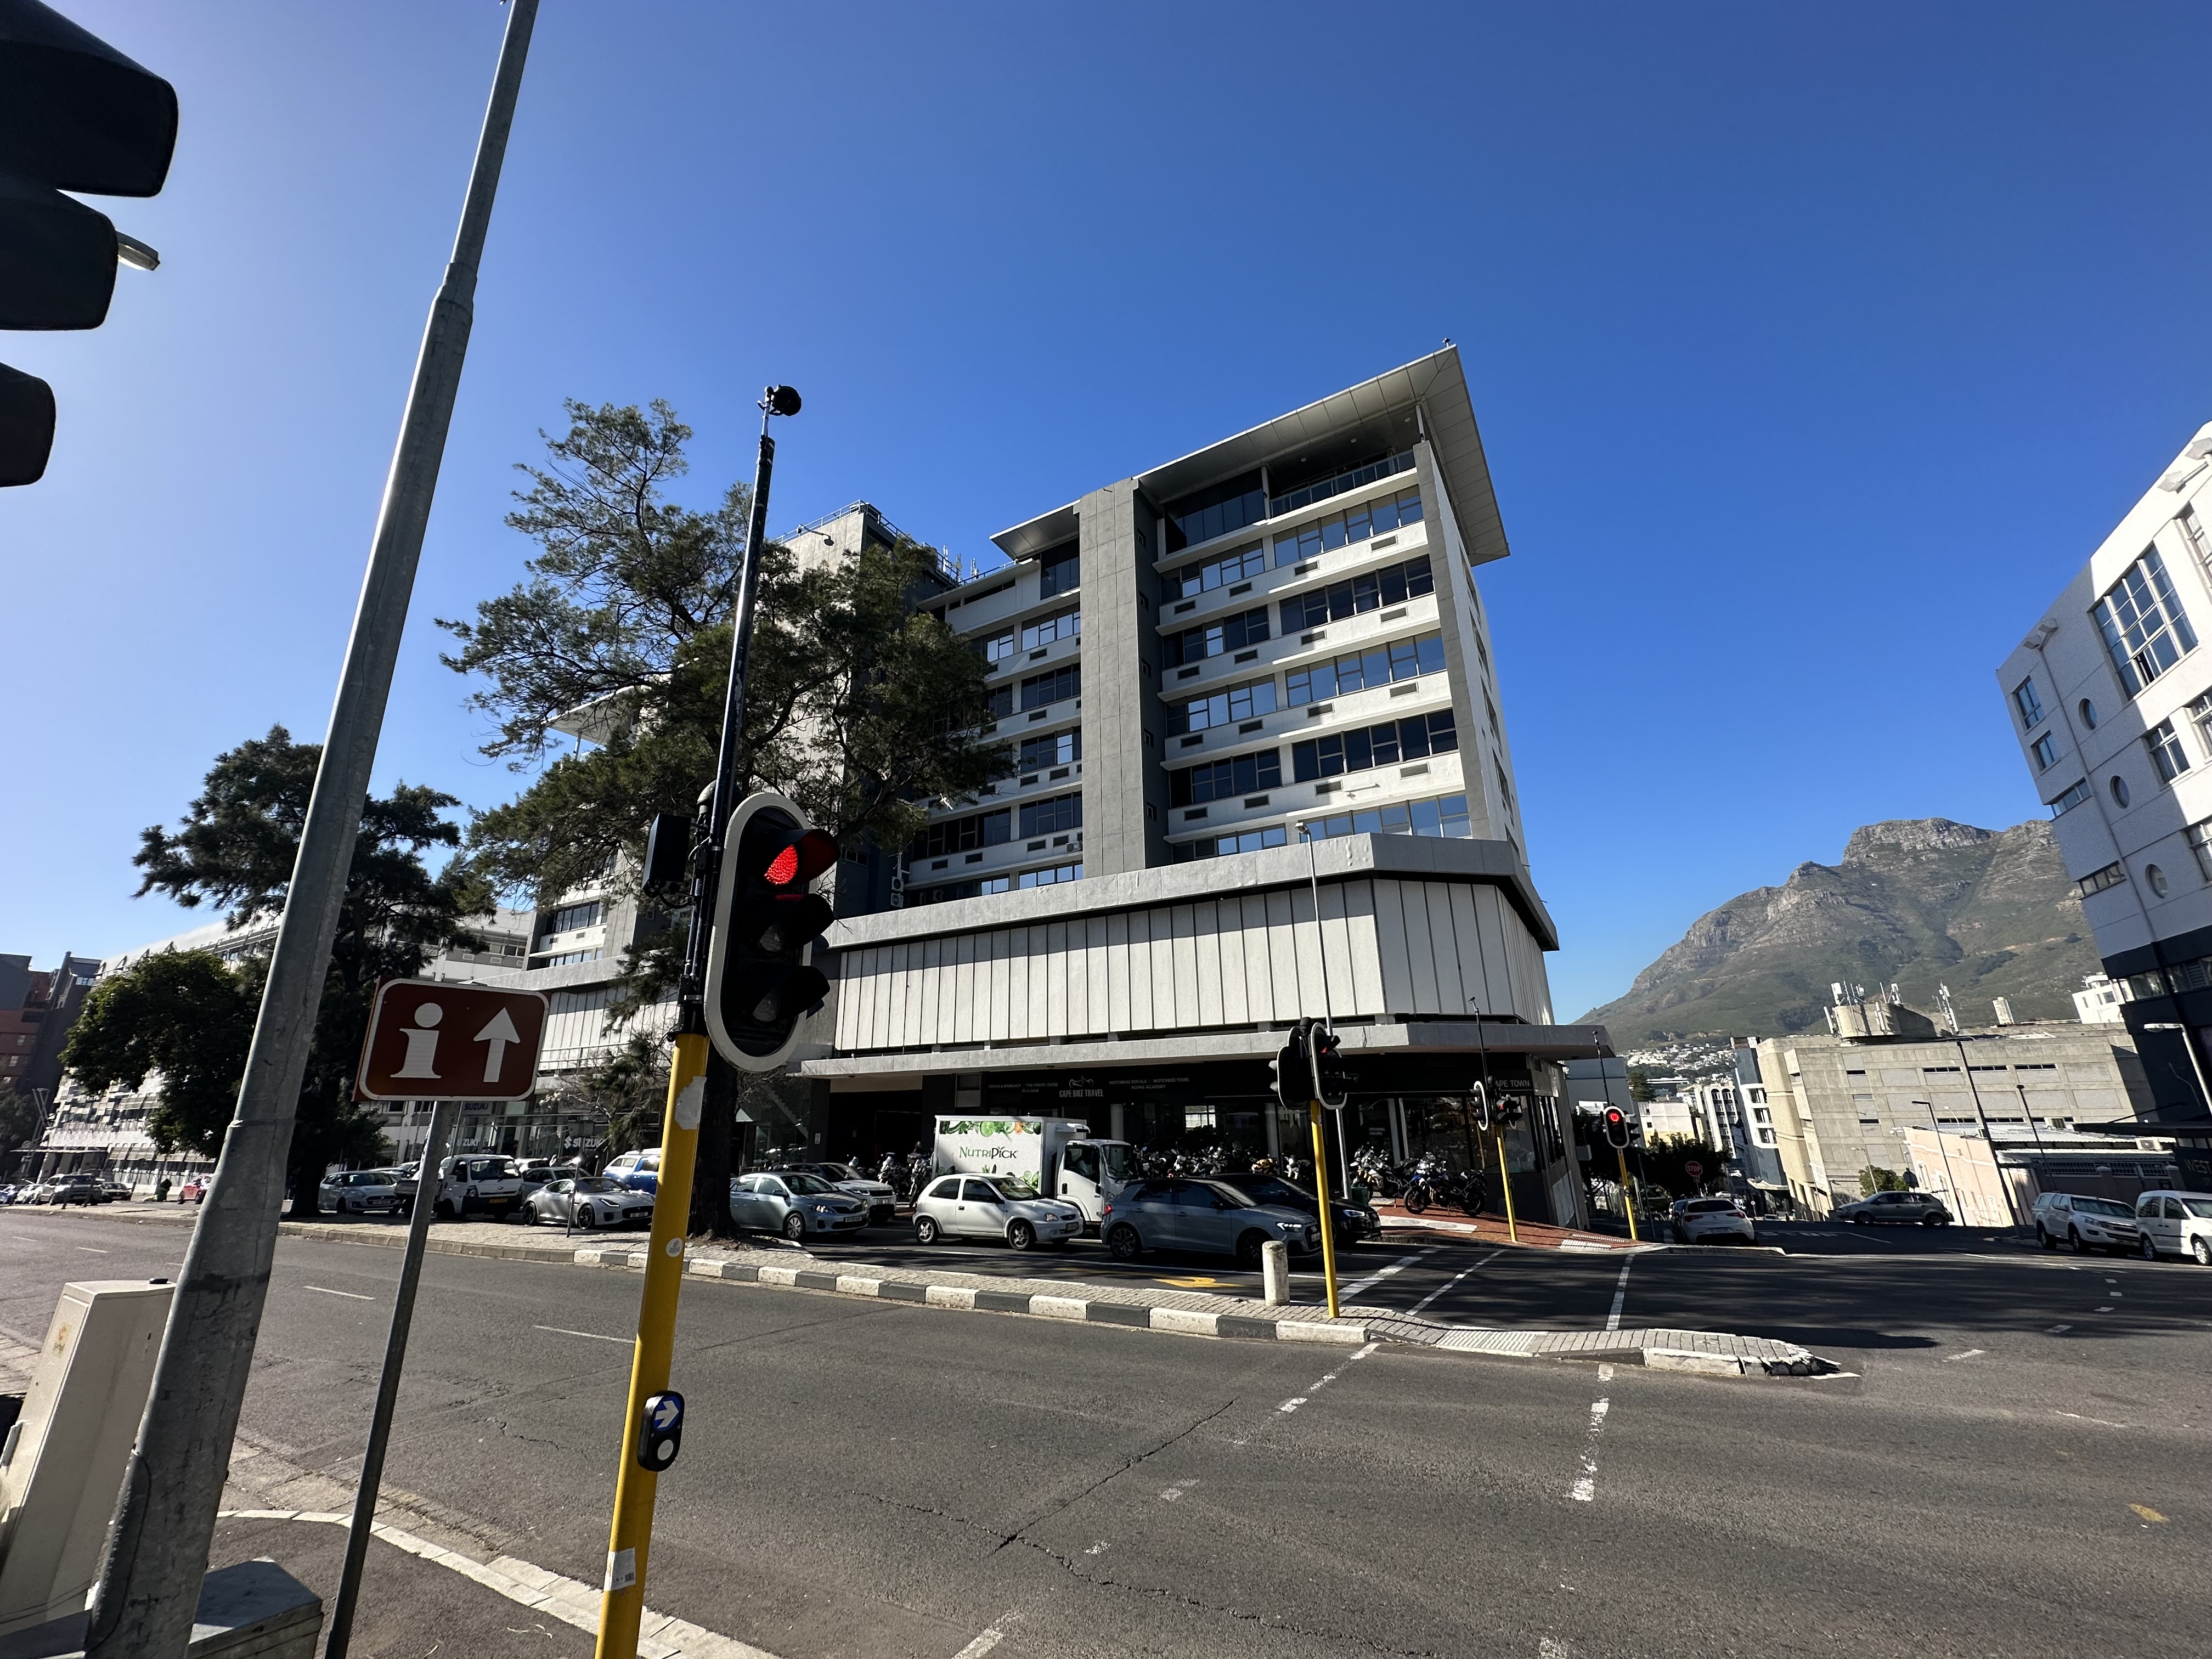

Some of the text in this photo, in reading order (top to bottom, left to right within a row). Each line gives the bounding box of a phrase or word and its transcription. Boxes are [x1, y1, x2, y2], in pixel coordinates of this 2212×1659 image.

[1510, 1079, 1530, 1087] TOWN
[1059, 1090, 1072, 1098] CAPE
[1085, 1088, 1104, 1097] TRAVEL
[465, 1102, 488, 1111] SUZUKI
[572, 1137, 603, 1148] SUZUK
